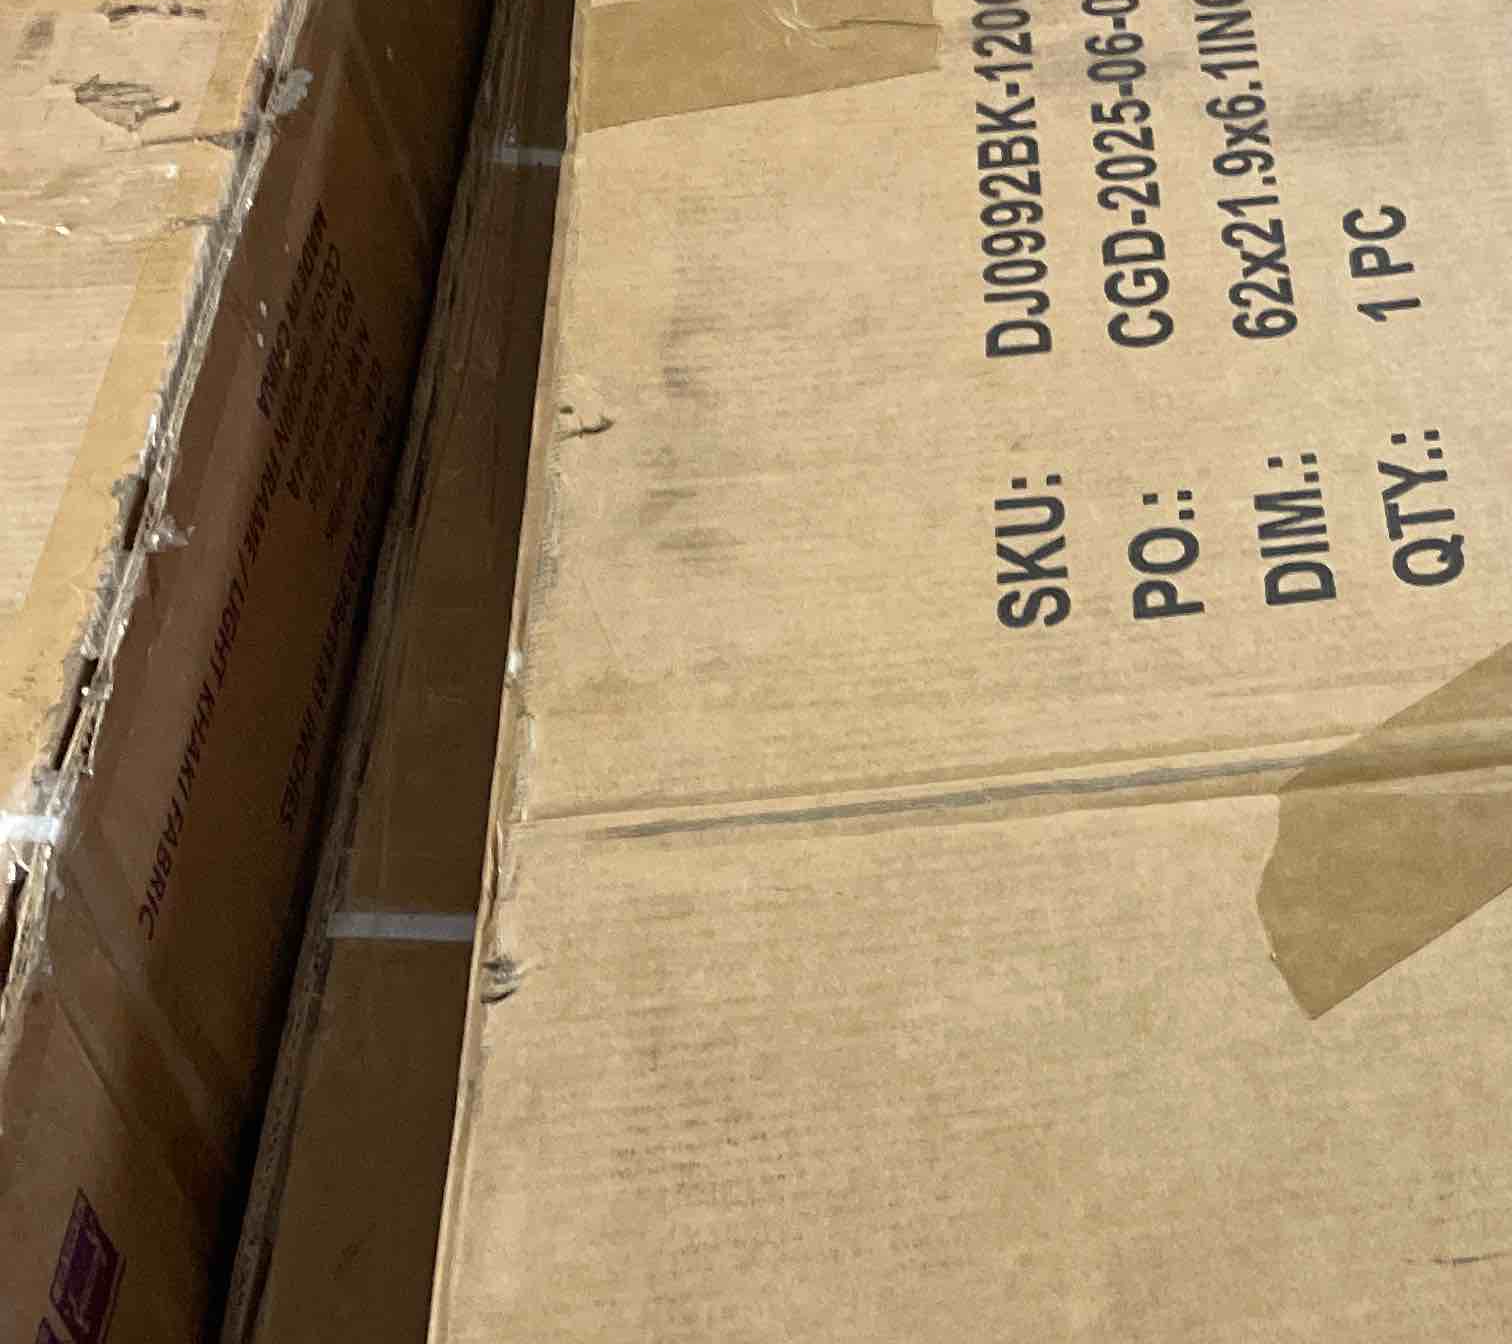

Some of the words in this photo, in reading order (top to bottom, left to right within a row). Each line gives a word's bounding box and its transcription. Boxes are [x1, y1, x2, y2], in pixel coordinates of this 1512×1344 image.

[297, 201, 325, 294] MADE
[1343, 204, 1416, 282] PC
[1357, 296, 1421, 323] 1
[258, 317, 290, 423] CHINA
[244, 446, 280, 562] FRAME
[995, 472, 1071, 628] SKU:
[1128, 488, 1205, 621] PO.:
[1253, 451, 1337, 607] DIM.:
[1378, 428, 1466, 587] QTY.:
[211, 577, 243, 682] LIGHT
[178, 684, 214, 800] KHAKI
[139, 800, 183, 941] FABRIC
